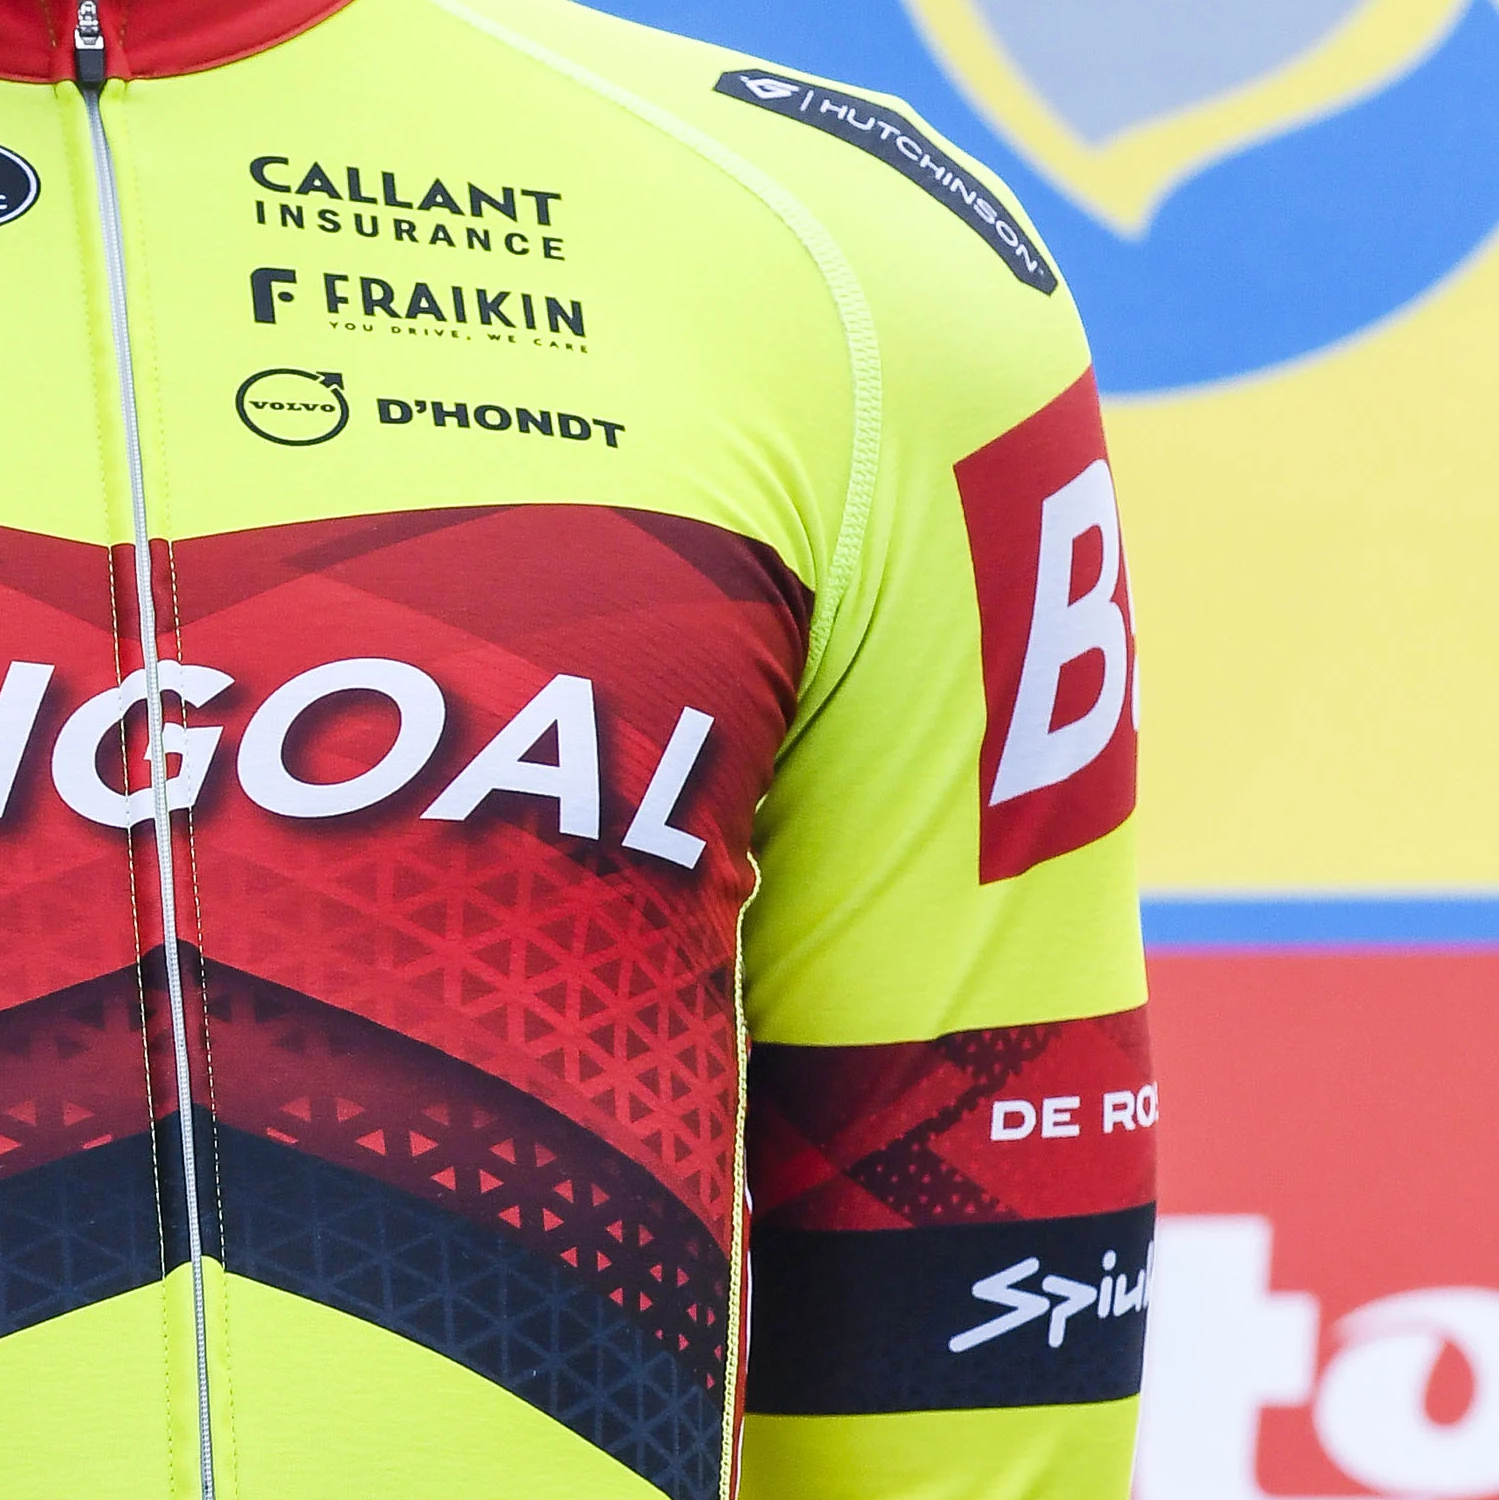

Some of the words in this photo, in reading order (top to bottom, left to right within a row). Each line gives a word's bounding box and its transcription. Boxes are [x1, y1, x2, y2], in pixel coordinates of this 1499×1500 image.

[249, 156, 562, 226] CALLANT
[819, 99, 1044, 275] HUTCHINSON
[255, 201, 567, 261] INSURANCE
[323, 272, 587, 338] FRAIKIN
[329, 321, 374, 332] YOU
[487, 332, 517, 344] WE
[533, 337, 589, 354] CARE
[249, 398, 336, 414] VOLVO
[376, 396, 626, 449] D'HONDT
[990, 1097, 1081, 1141] DE
[1102, 1082, 1159, 1134] RO
[948, 1240, 1155, 1353] Spiu
